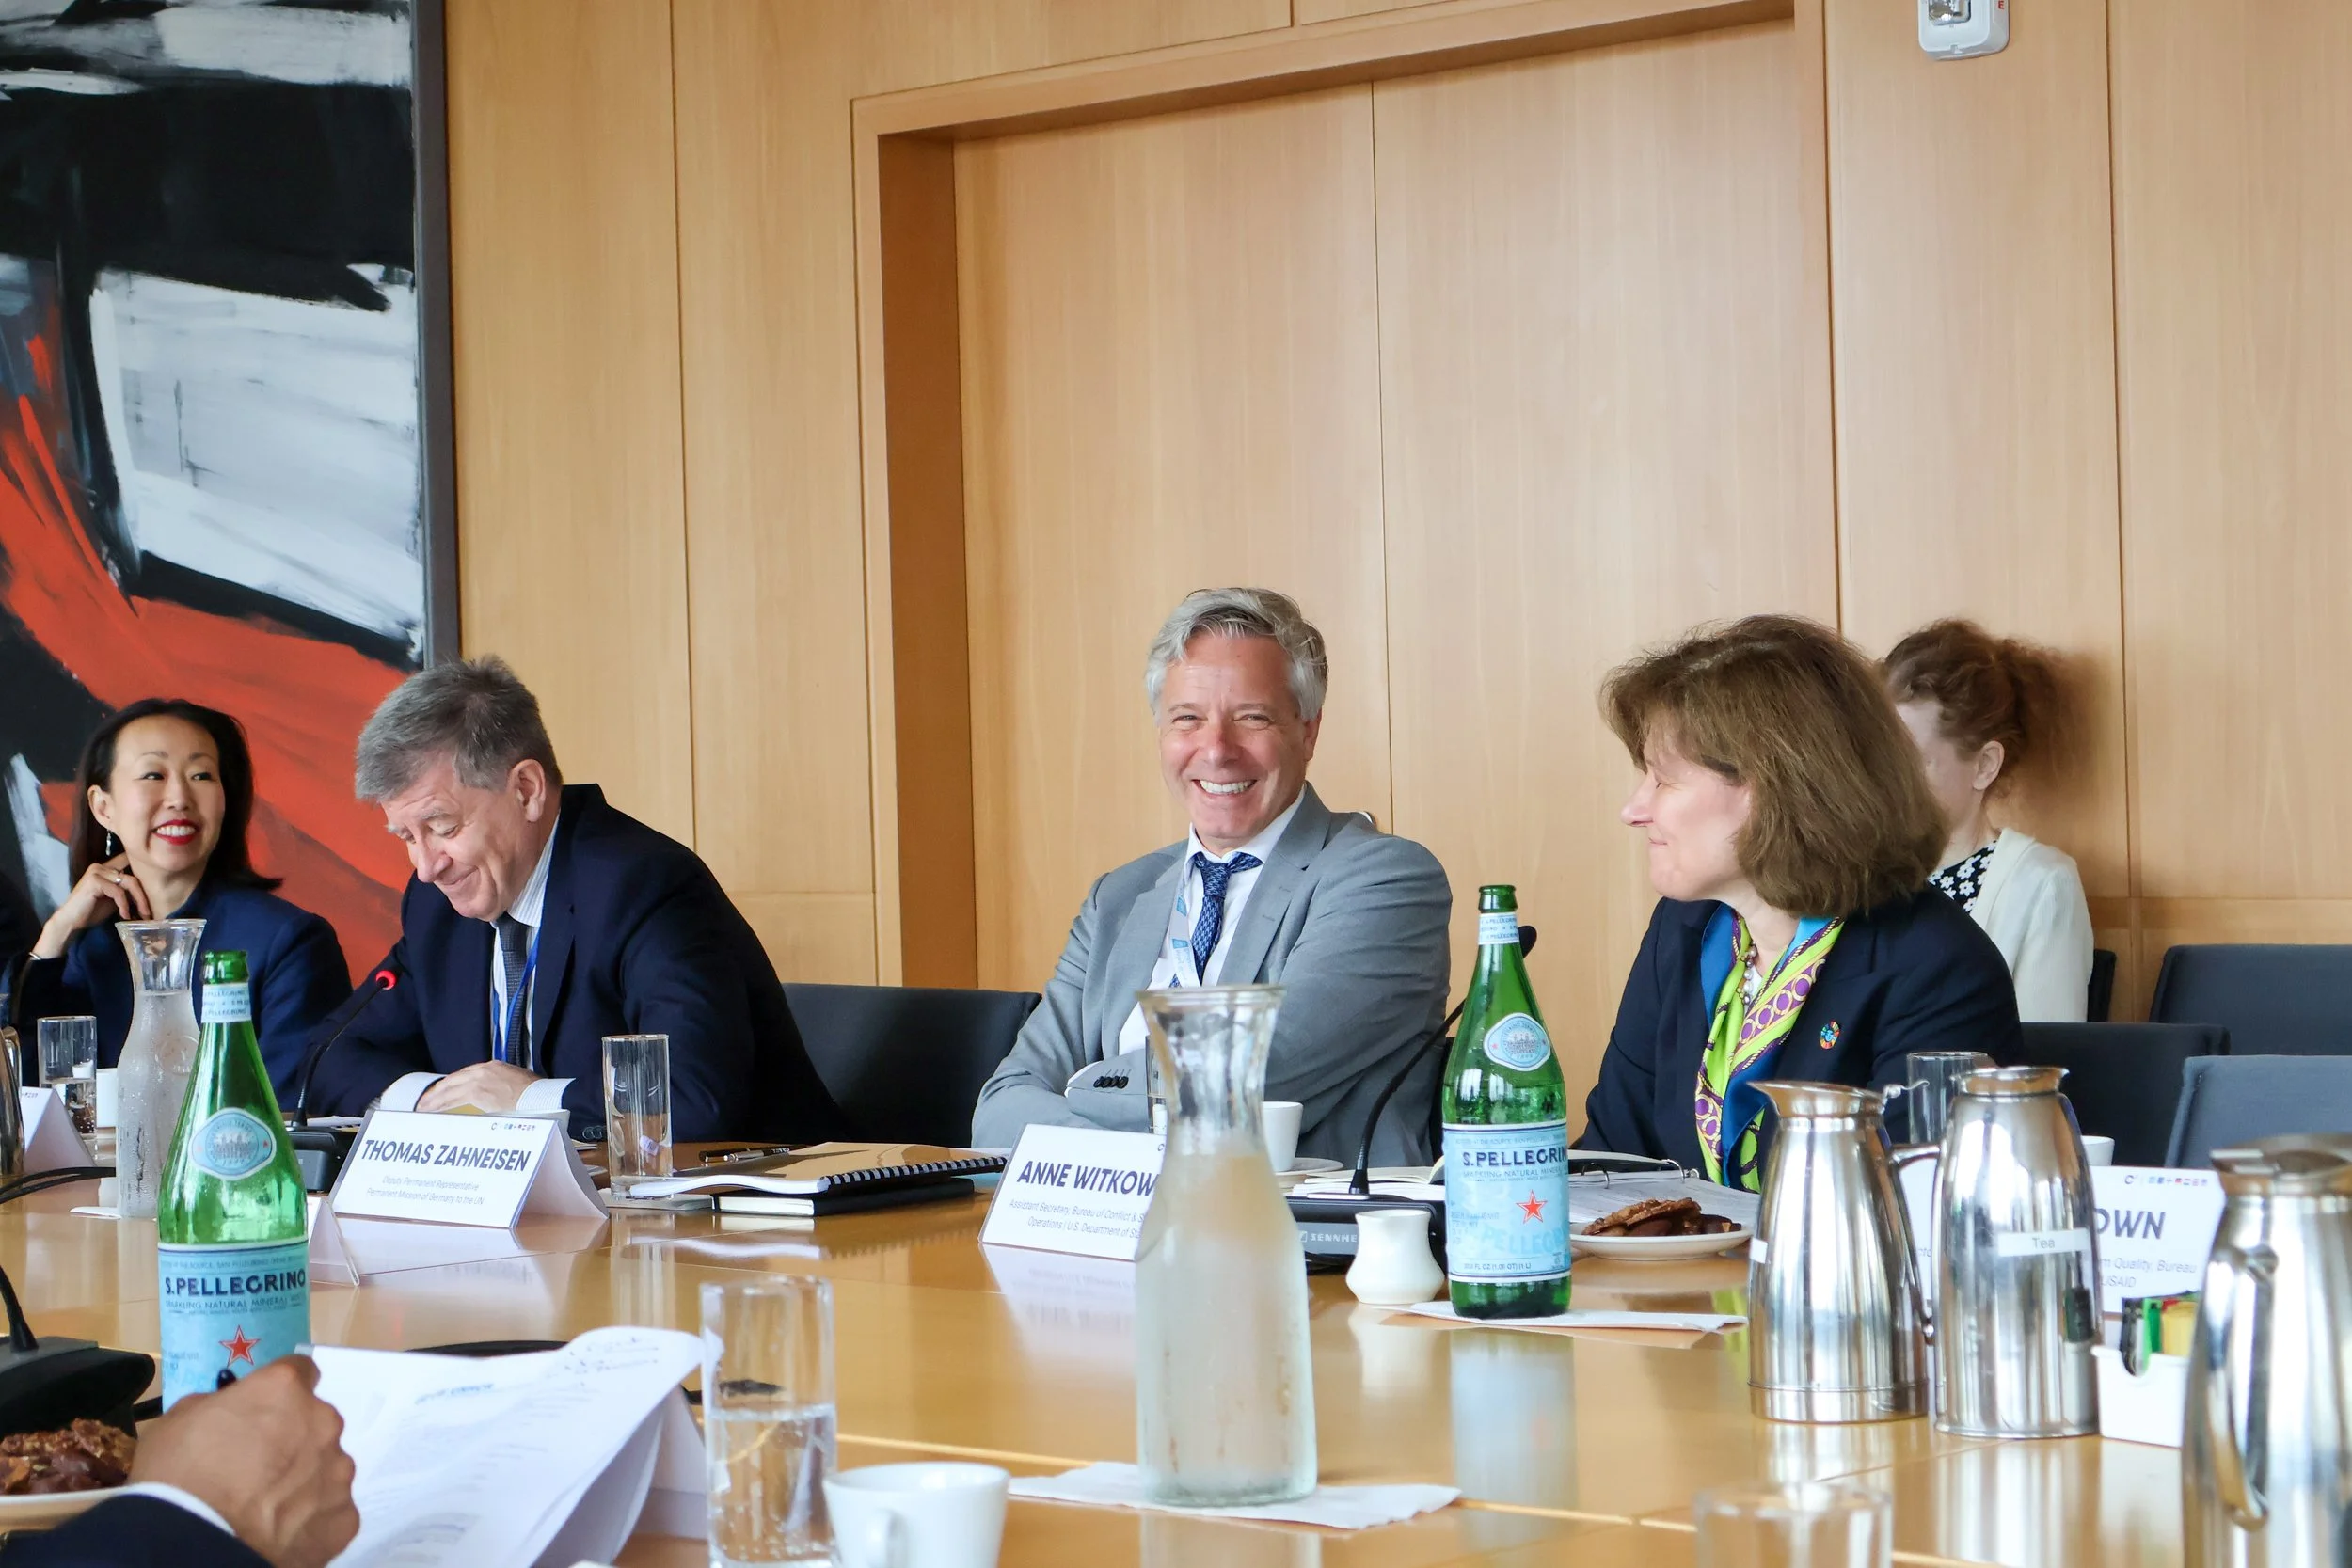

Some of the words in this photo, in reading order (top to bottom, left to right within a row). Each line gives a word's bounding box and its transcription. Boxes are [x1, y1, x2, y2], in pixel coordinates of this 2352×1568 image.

[361, 1140, 435, 1164] THOMAS
[434, 1145, 532, 1172] ZAHNEISEN
[1463, 1146, 1567, 1167] S.PELLEGRIN
[1017, 1160, 1073, 1187] ANNE
[1073, 1165, 1160, 1197] WITKOW
[1504, 1168, 1539, 1178] NATURAL
[404, 1177, 436, 1187] Permanent
[437, 1180, 479, 1191] Representative
[367, 1187, 398, 1196] Permanent
[398, 1190, 421, 1199] Mission
[429, 1193, 454, 1204] Germany
[473, 1196, 485, 1205] UN
[1009, 1198, 1039, 1211] Assistant
[1039, 1202, 1071, 1215] Secretary,
[1072, 1205, 1094, 1217] Bureau
[1096, 1208, 1105, 1218] of
[1104, 1210, 1131, 1221] Conflict
[1027, 1216, 1063, 1230] Operations
[1081, 1223, 1120, 1237] Department
[1120, 1227, 1130, 1237] of
[1130, 1228, 1141, 1239] Sta
[2094, 1208, 2166, 1240] OWN
[1310, 1233, 1358, 1243] SENNHE
[2031, 1236, 2056, 1249] Tea
[2157, 1259, 2197, 1274] Bureau
[165, 1268, 306, 1297] S.PELLEGRINO
[205, 1299, 247, 1309] NATURAL
